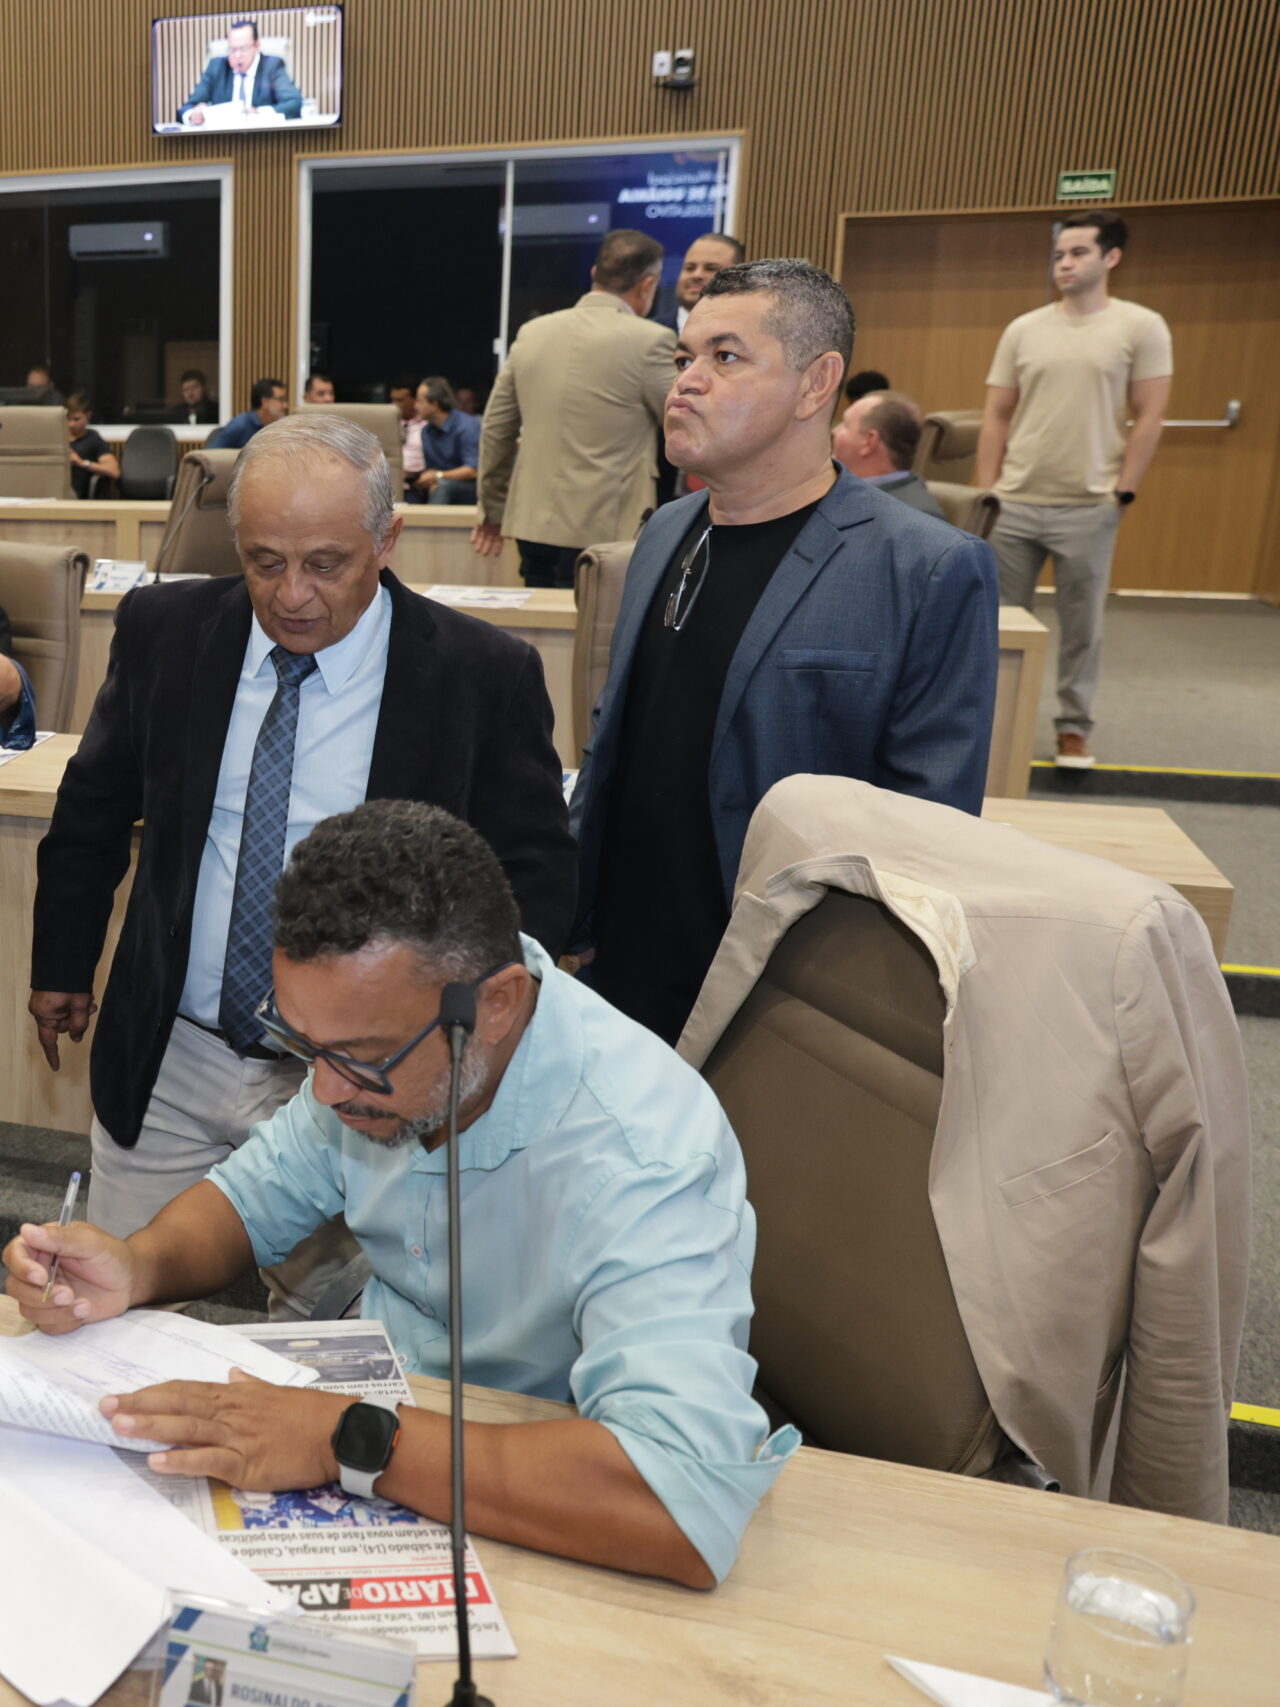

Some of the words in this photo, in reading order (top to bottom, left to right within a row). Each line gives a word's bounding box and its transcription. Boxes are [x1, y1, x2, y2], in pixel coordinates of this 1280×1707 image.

[216, 1531, 267, 1543] políticas
[265, 1532, 299, 1543] vidas
[297, 1531, 326, 1541] suas
[325, 1531, 341, 1541] de
[340, 1531, 367, 1541] fase
[365, 1529, 395, 1539] nova
[393, 1529, 430, 1539] selam
[239, 1547, 284, 1557] Caiado
[283, 1544, 337, 1555] Jaraguá,
[337, 1544, 359, 1554] em
[357, 1542, 388, 1554] (14),
[387, 1542, 433, 1553] sábado
[340, 1586, 364, 1599] DE
[358, 1612, 382, 1623] Zero
[382, 1610, 413, 1622] Tarifa
